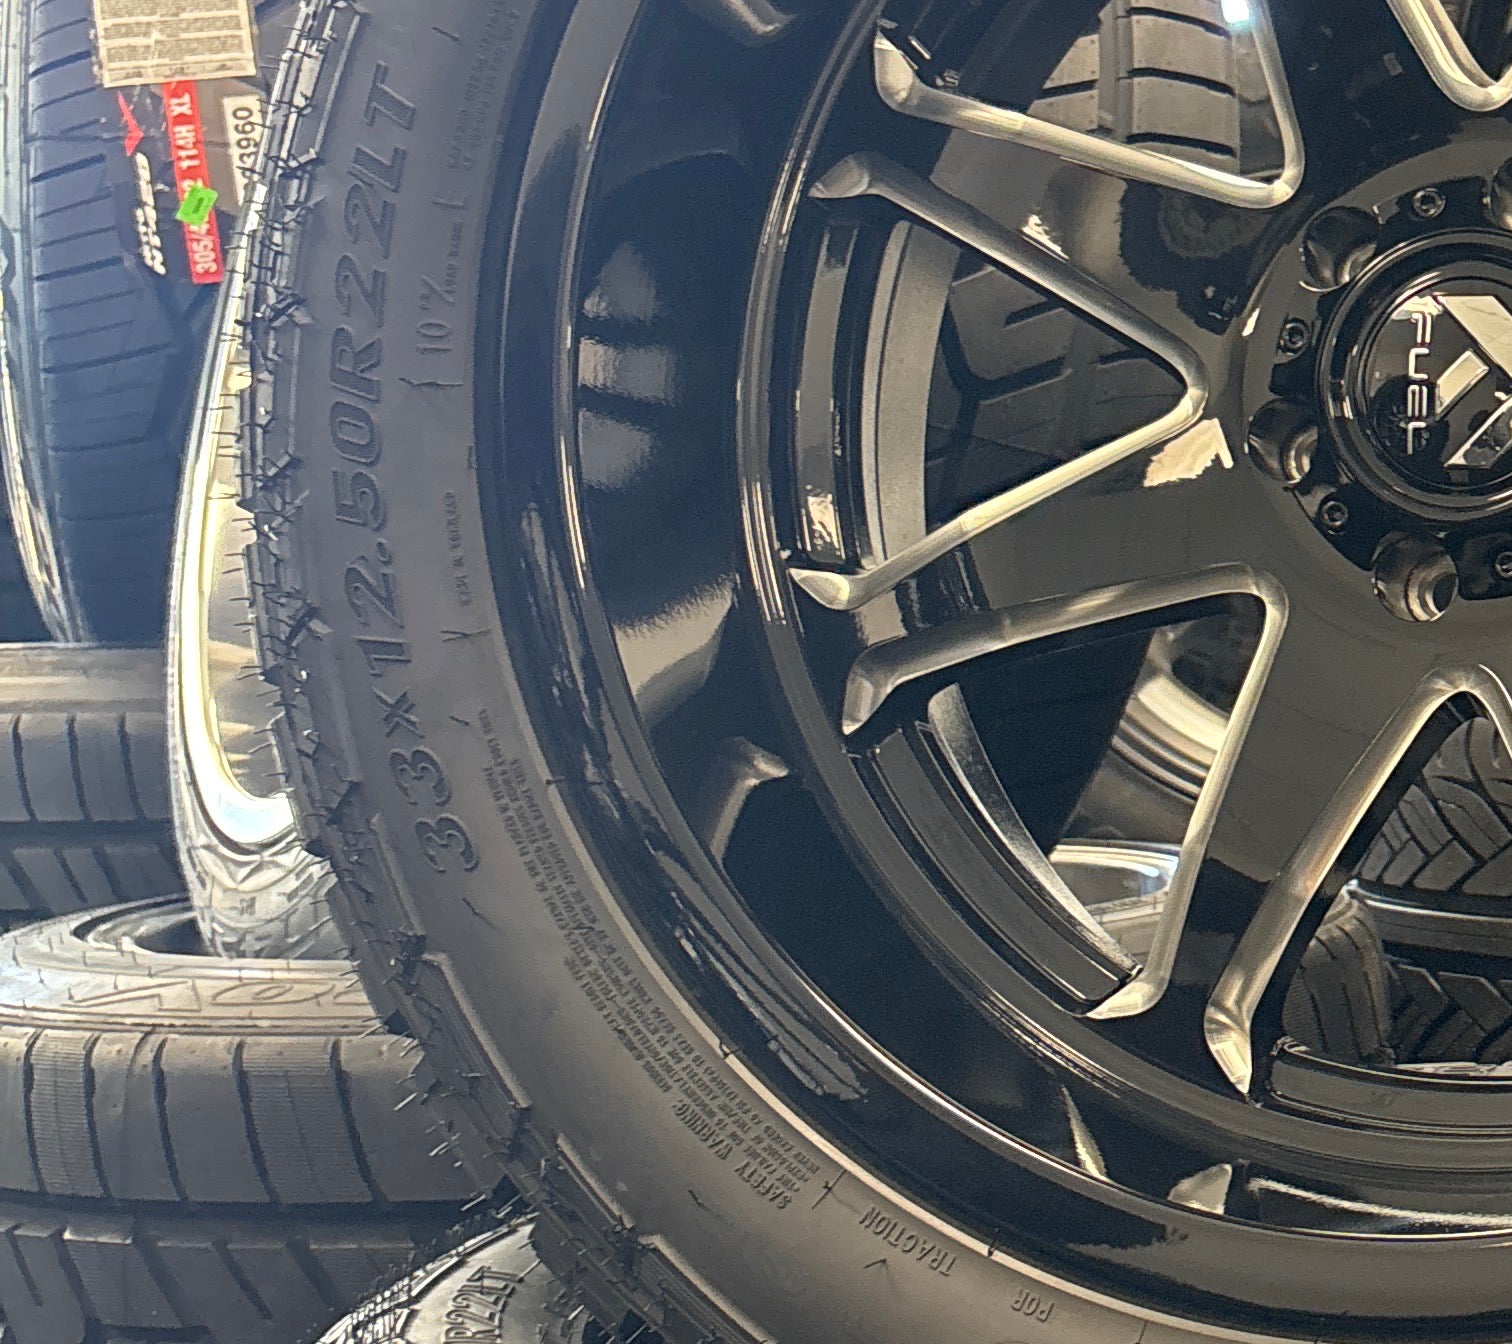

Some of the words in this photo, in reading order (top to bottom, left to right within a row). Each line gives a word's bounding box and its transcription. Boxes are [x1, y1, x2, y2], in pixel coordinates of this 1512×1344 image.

[168, 92, 194, 117] XL
[172, 125, 202, 171] 114H
[857, 1203, 960, 1279] TRACTION
